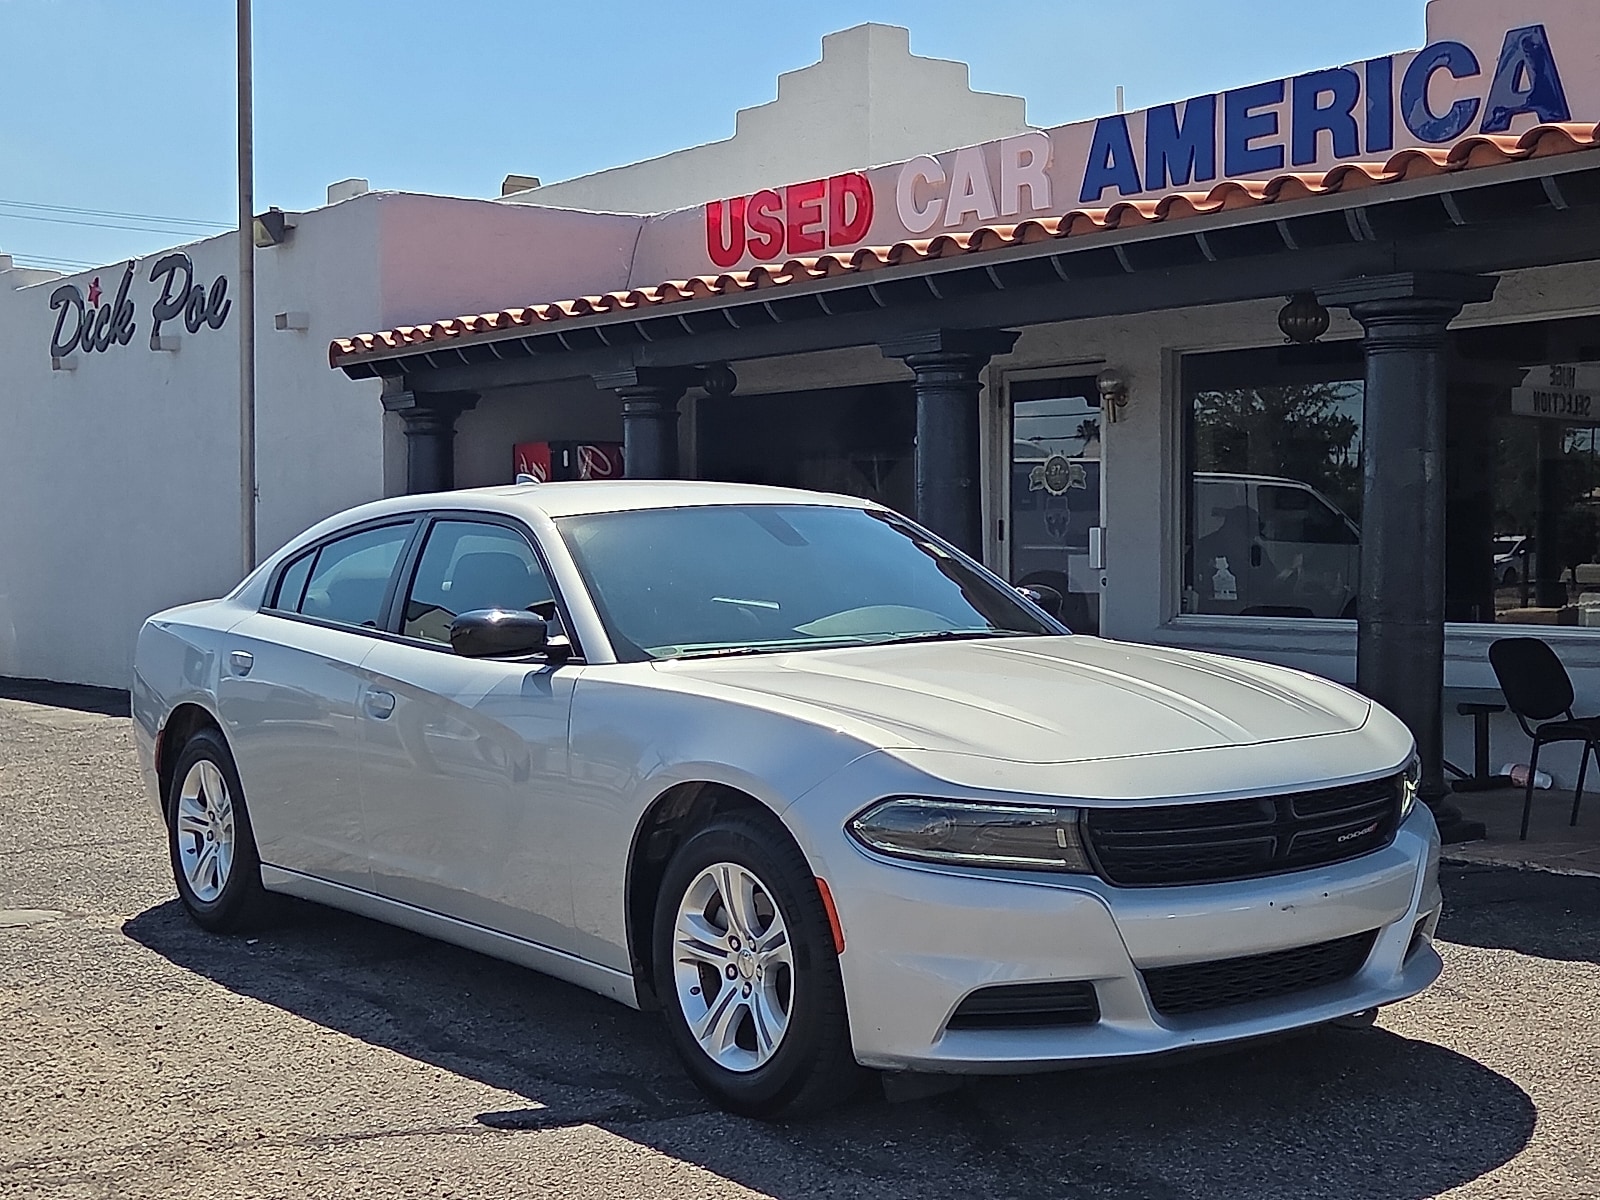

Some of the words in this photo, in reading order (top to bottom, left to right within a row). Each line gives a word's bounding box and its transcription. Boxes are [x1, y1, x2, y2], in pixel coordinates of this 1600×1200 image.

[705, 171, 875, 267] USED
[896, 139, 1054, 234] CAR
[1078, 24, 1572, 202] AMERICA
[49, 259, 136, 358] Dick
[148, 251, 232, 338] Poe
[1337, 824, 1375, 842] DODGE
